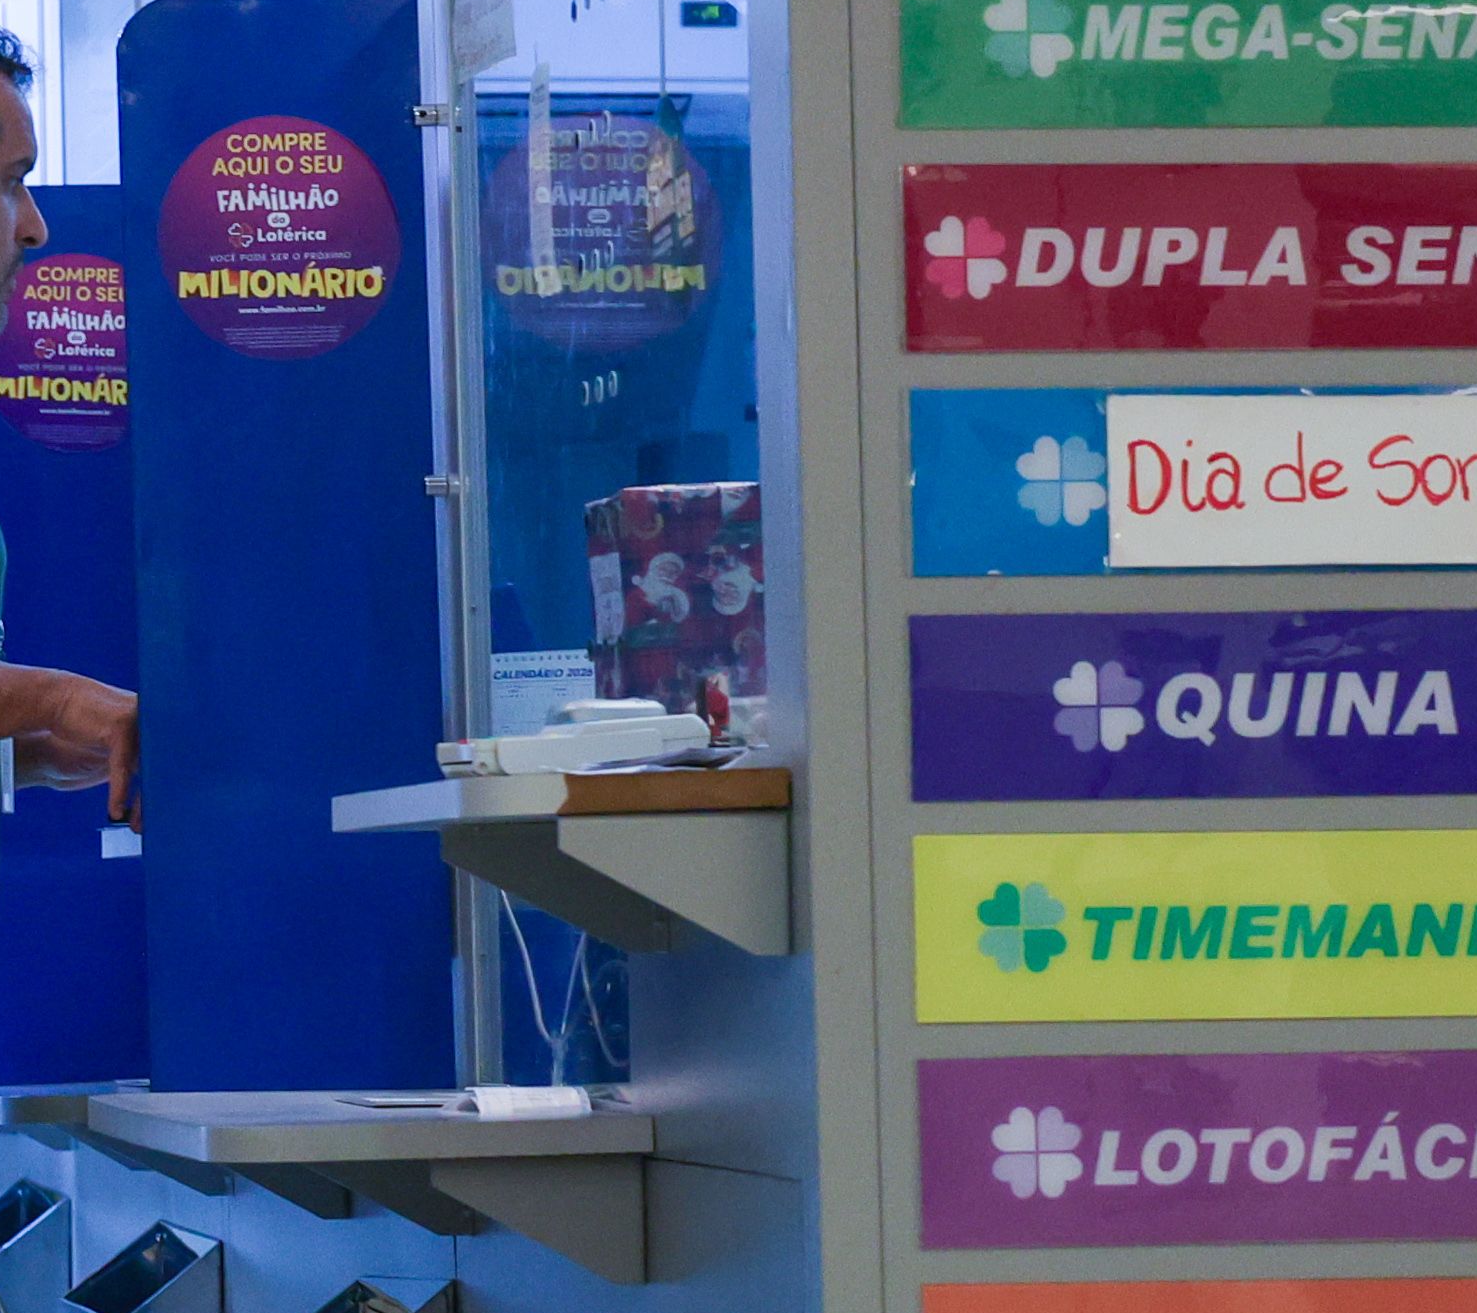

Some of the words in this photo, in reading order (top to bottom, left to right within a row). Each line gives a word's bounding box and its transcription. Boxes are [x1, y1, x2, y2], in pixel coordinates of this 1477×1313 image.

[227, 132, 327, 153] COMPRE
[212, 157, 269, 177] AQUI
[276, 157, 293, 174] O
[300, 155, 343, 174] SEU
[257, 227, 327, 242] Lotérica
[1015, 226, 1308, 287] DUPLA
[37, 266, 120, 283] COMPRE
[178, 261, 383, 299] MILIONÁRIO
[24, 284, 71, 302] AQUI
[76, 287, 91, 301] O
[58, 344, 115, 357] Lotérica
[1127, 438, 1246, 515] Dia
[1263, 431, 1349, 503] de
[1154, 670, 1459, 747] QUINA
